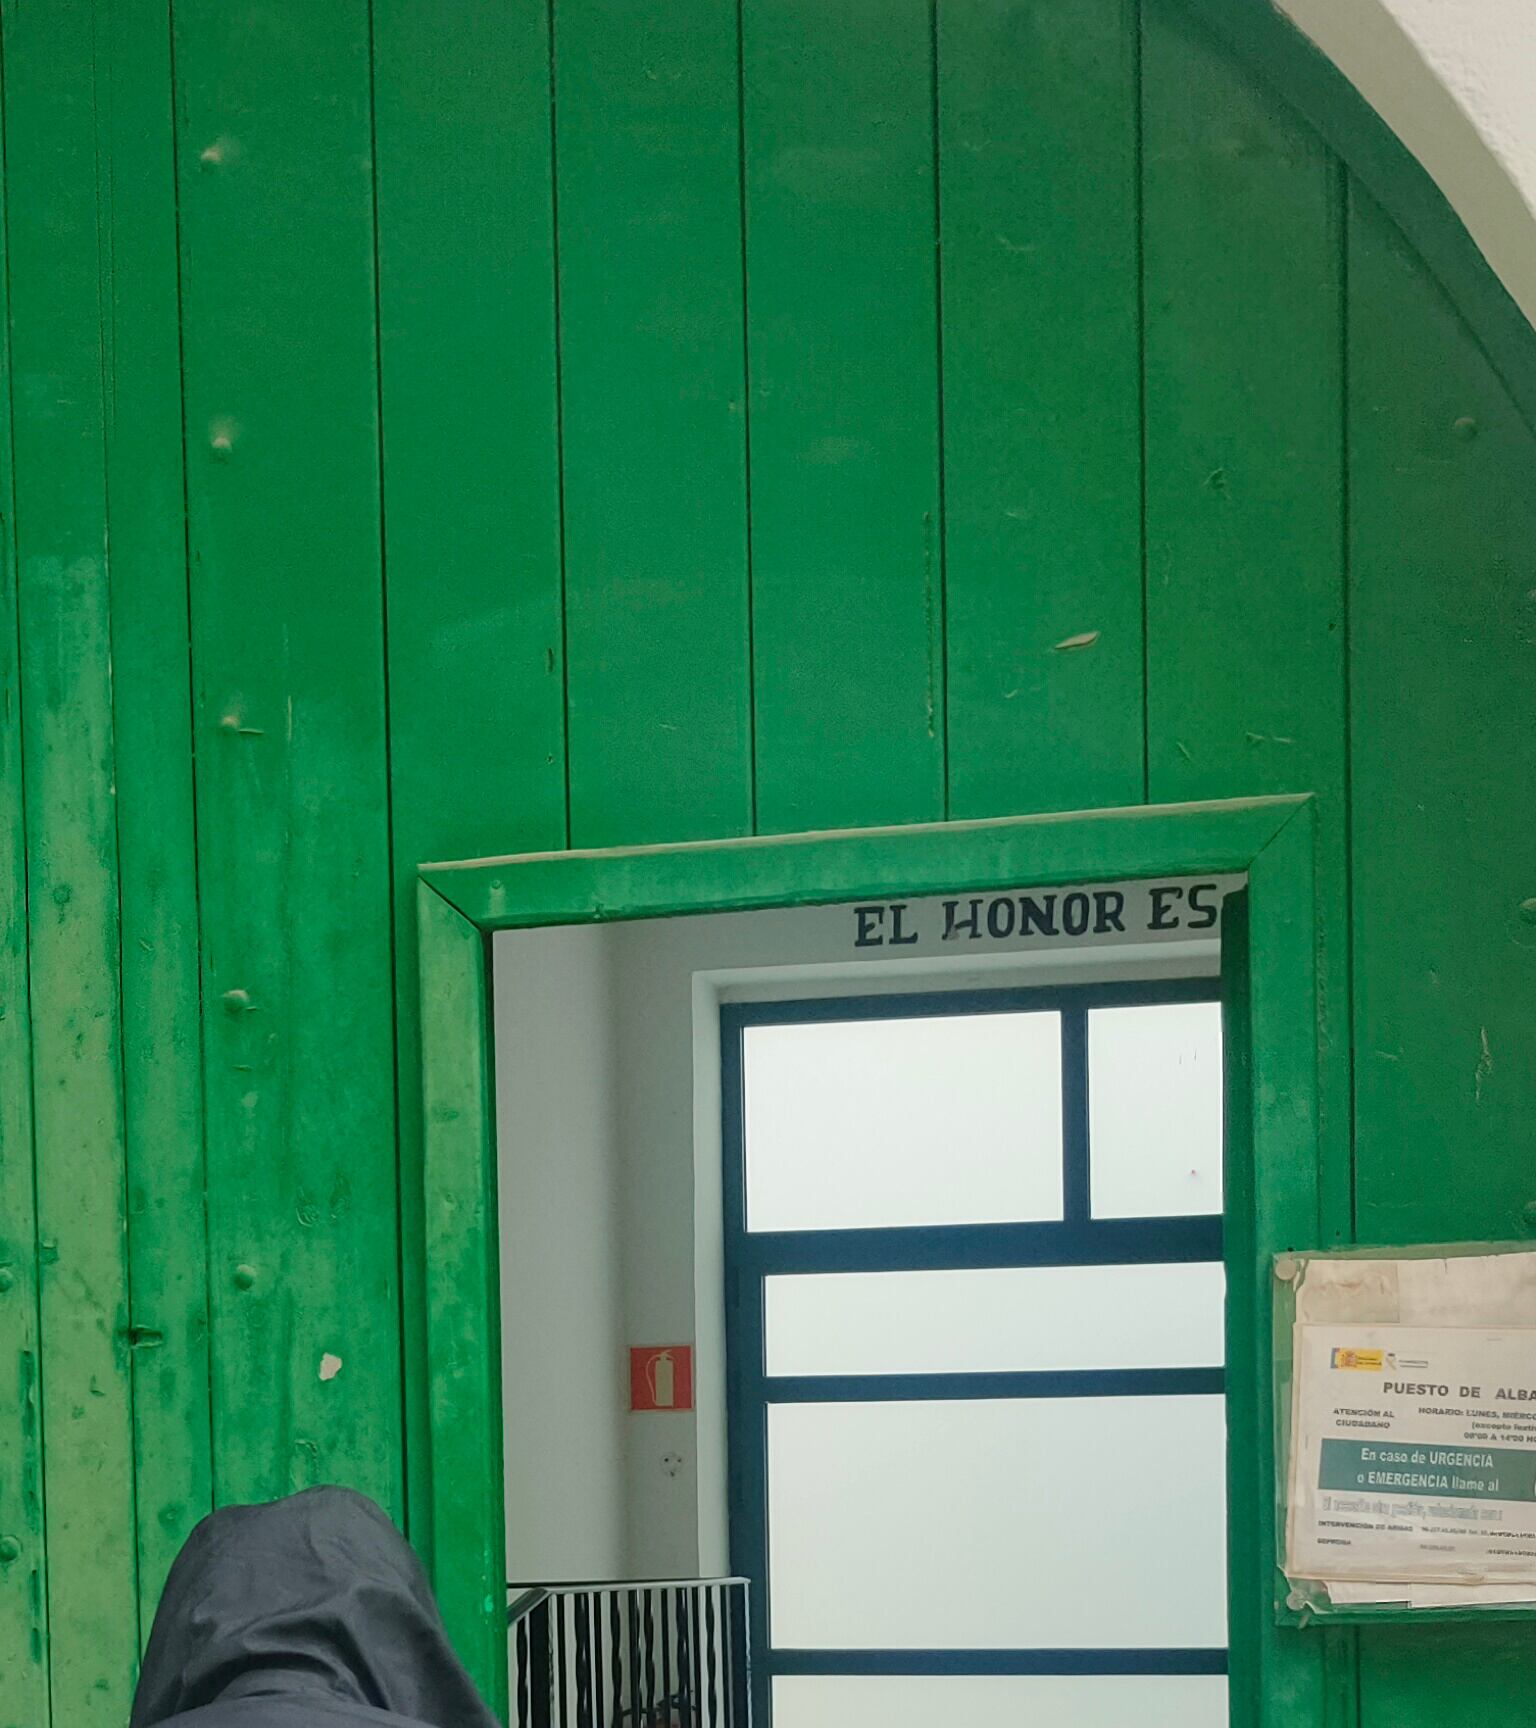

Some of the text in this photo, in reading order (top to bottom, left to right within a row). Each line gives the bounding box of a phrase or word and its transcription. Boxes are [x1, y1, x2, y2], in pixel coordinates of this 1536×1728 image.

[853, 884, 1217, 947] EL HONOR ES
[1383, 1382, 1449, 1397] PUESTO
[1459, 1386, 1481, 1398] DE
[1361, 1448, 1494, 1468] En caso de URGENCIA
[1357, 1471, 1499, 1492] o EMERGENCIA llame al
